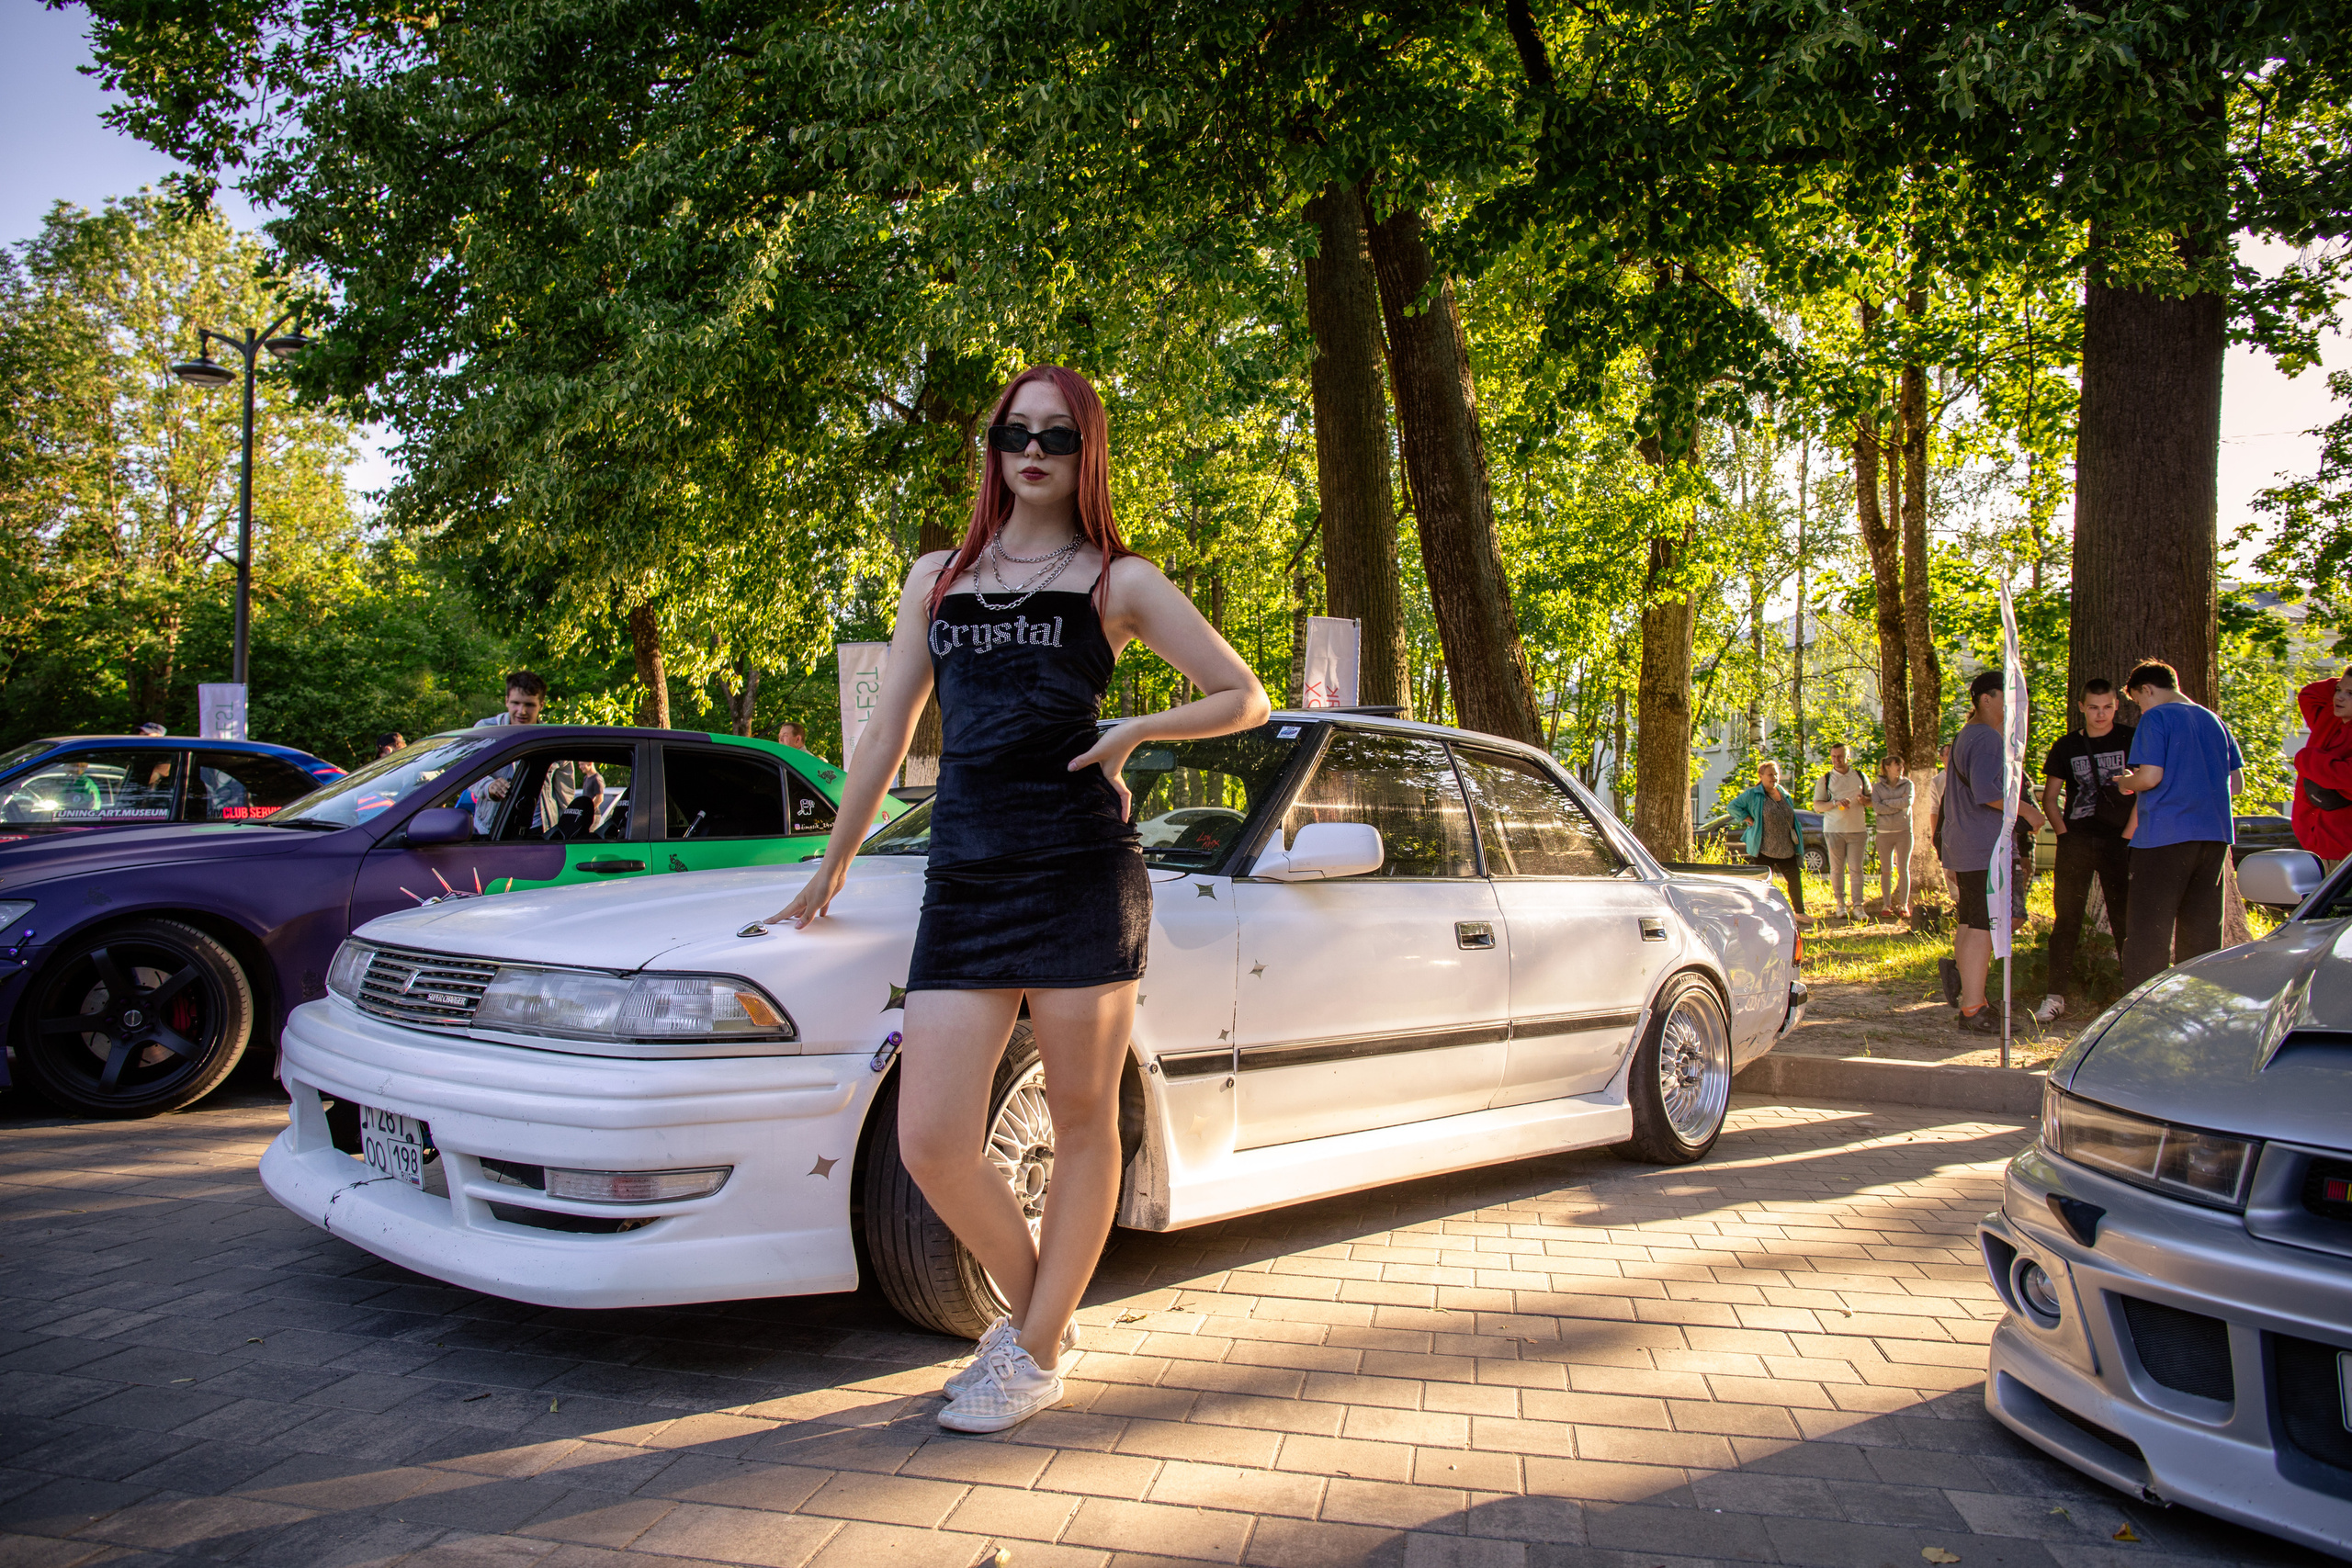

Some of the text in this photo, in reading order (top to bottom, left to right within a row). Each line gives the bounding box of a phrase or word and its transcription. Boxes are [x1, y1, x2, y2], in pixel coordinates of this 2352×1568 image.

[929, 615, 1063, 659] Crystal
[2075, 756, 2121, 771] GRA WOLF
[52, 808, 168, 818] TUNING.ART.MUSEUM
[222, 807, 249, 819] CLUB
[393, 1145, 418, 1174] 198
